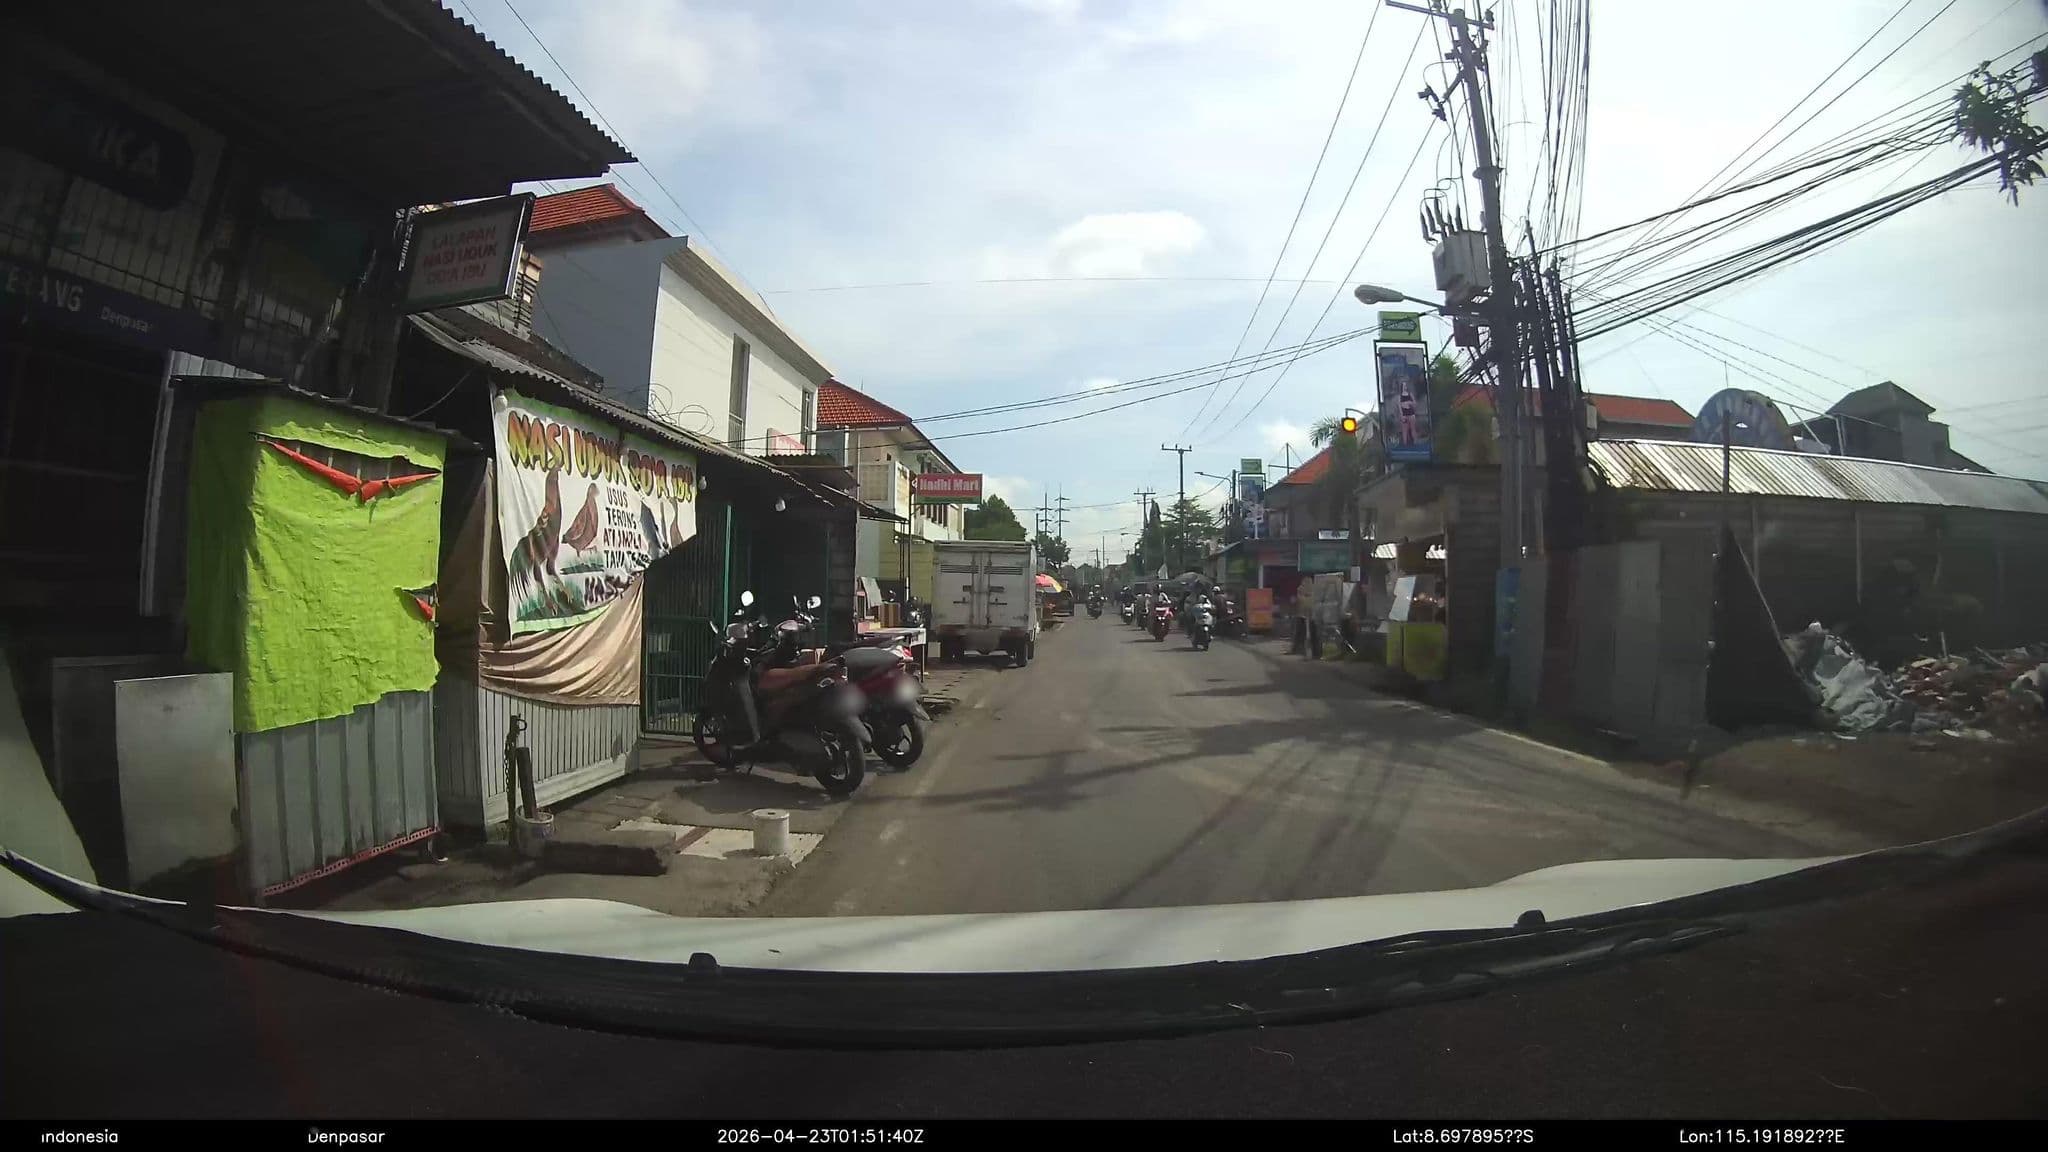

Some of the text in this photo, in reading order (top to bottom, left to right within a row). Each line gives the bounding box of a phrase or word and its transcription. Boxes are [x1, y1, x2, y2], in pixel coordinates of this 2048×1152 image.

[508, 410, 571, 476] NASI
[573, 427, 627, 487] UDUK
[953, 478, 979, 490] Mart
[607, 486, 628, 508] USUS
[603, 527, 616, 548] ATI
